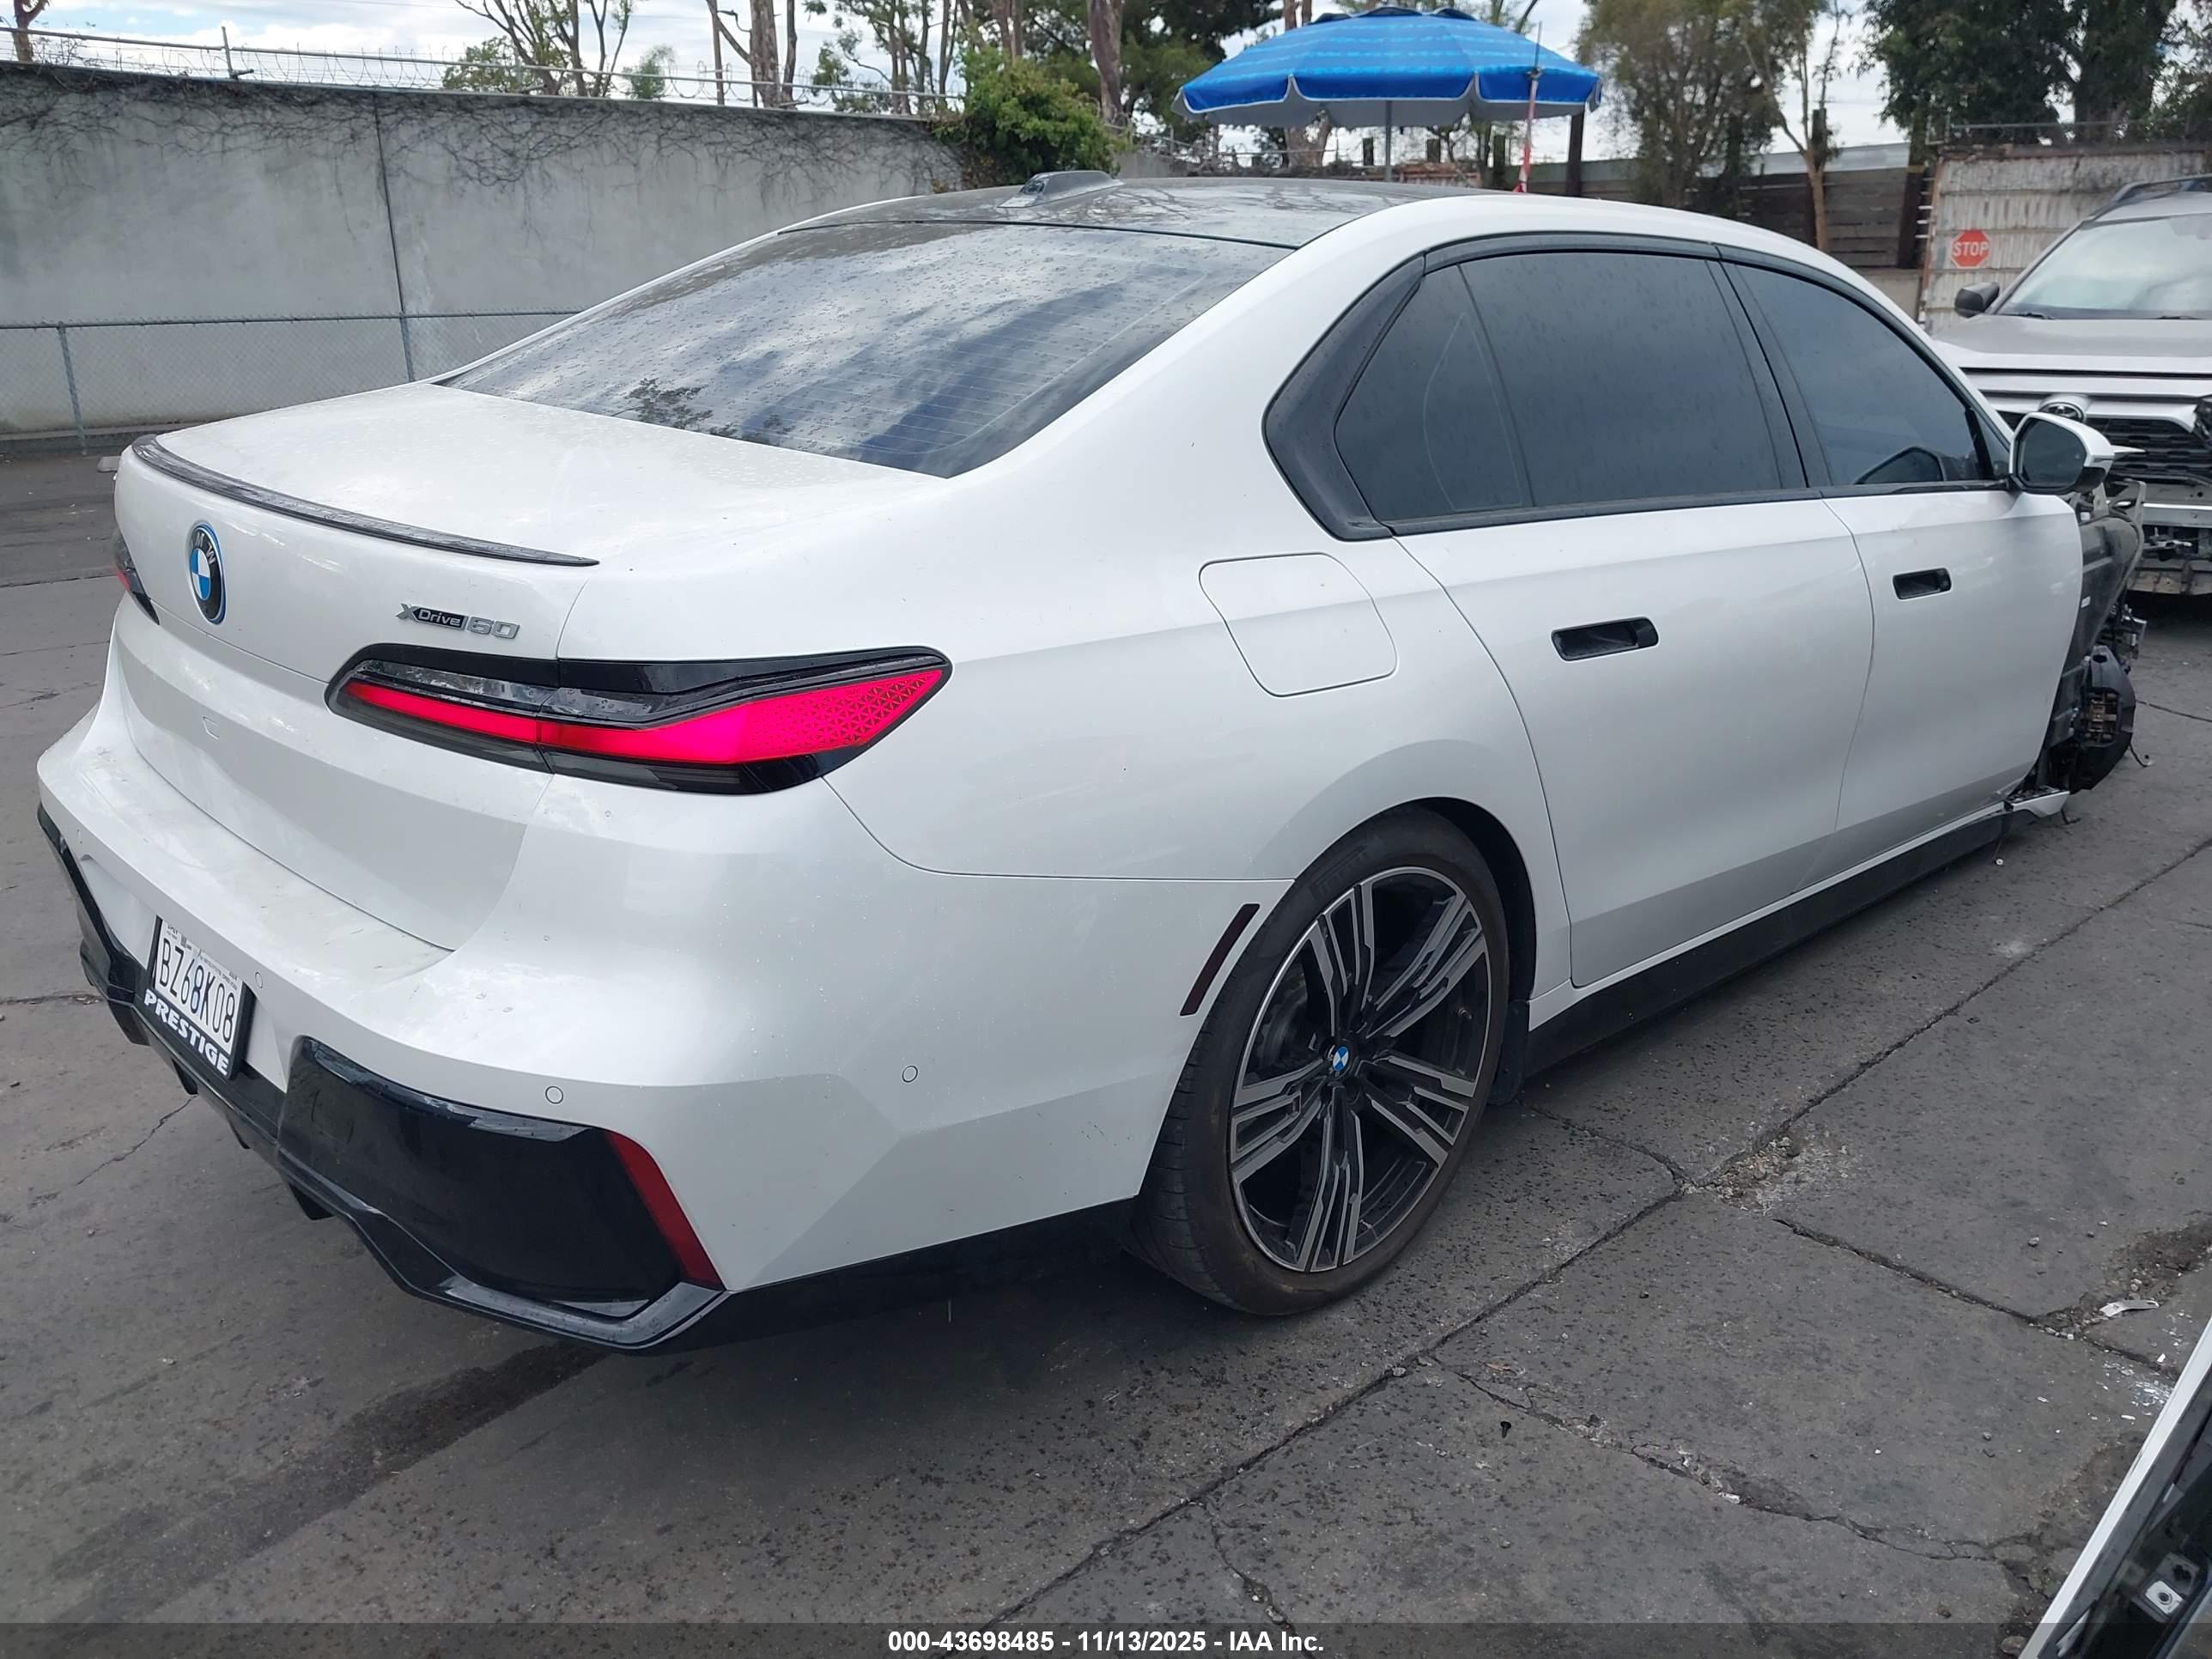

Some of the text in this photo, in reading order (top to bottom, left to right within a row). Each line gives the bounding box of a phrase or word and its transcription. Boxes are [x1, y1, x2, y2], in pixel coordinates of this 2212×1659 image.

[1953, 241, 1989, 257] STOP
[143, 988, 229, 1076] PRESTIGE
[159, 937, 235, 1043] BZ68K08
